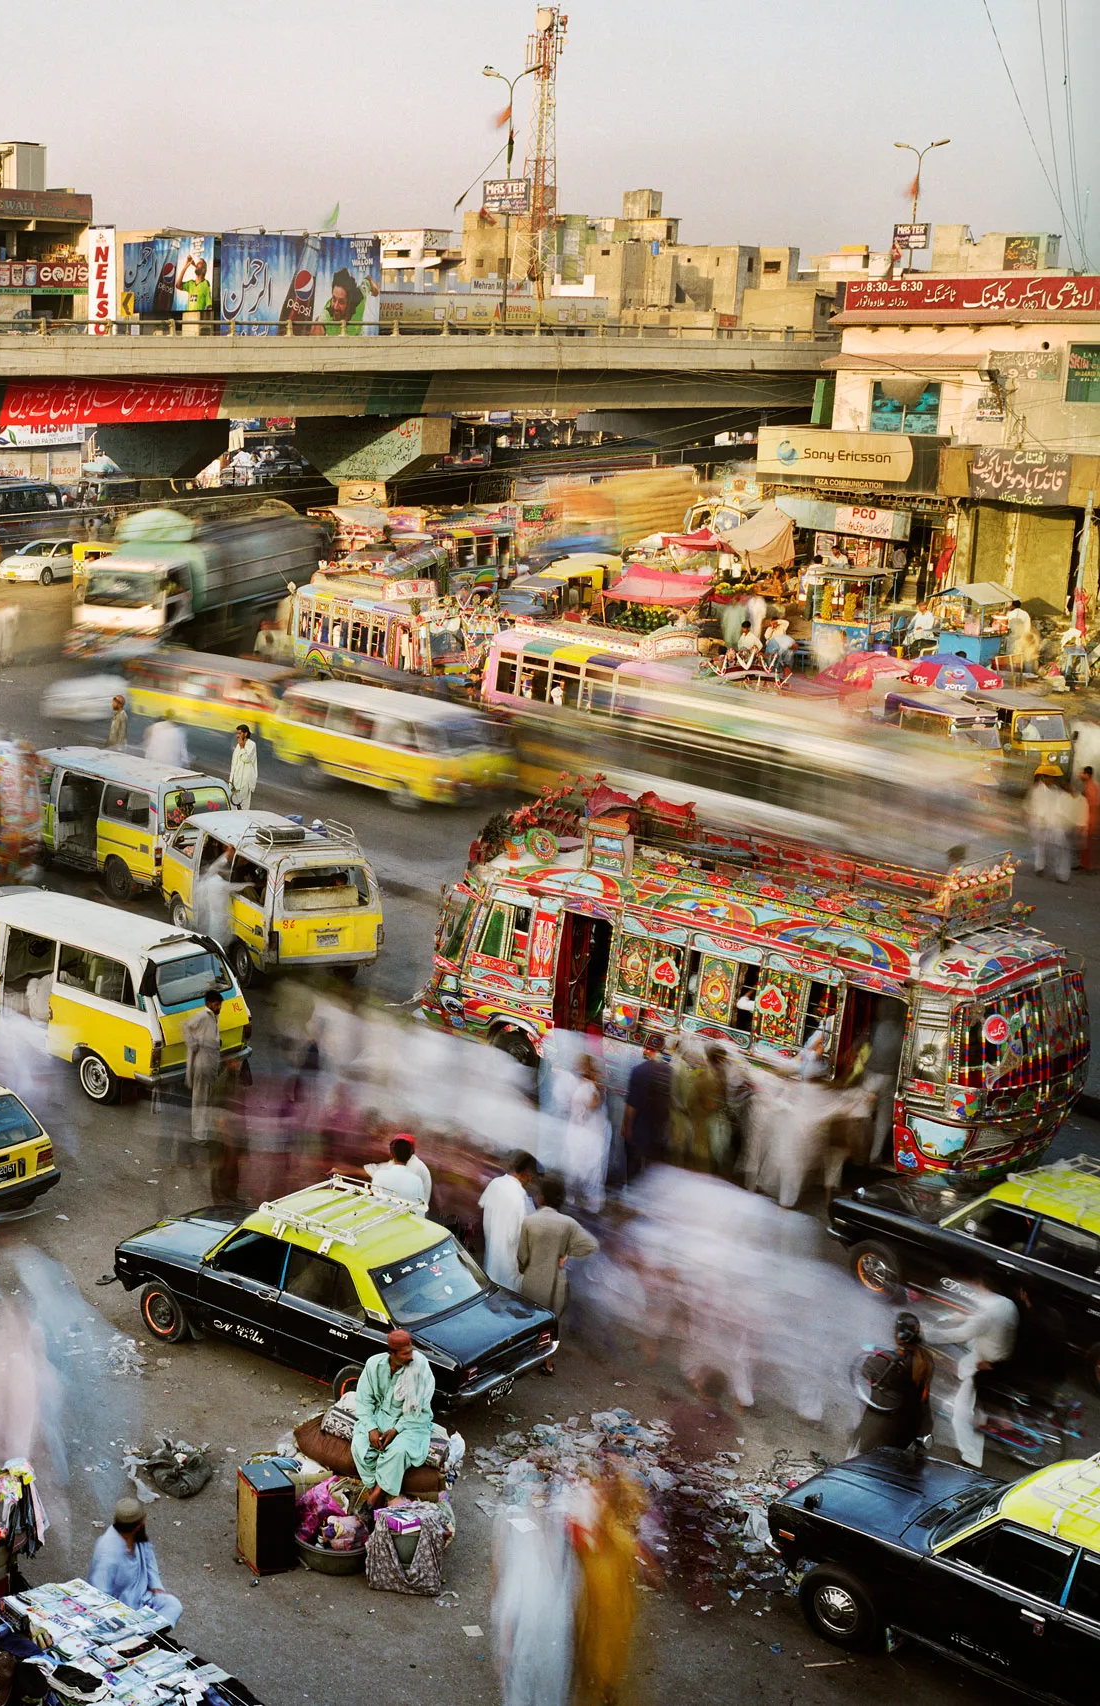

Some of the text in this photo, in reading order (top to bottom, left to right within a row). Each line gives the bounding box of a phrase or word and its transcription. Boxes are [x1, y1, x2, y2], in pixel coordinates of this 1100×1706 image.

[474, 280, 495, 290] Mehran
[286, 297, 311, 317] pepsi
[804, 448, 891, 464] Sony Ericsson
[815, 478, 884, 489] FIZA COMMUNICATION
[852, 506, 876, 520] PCO
